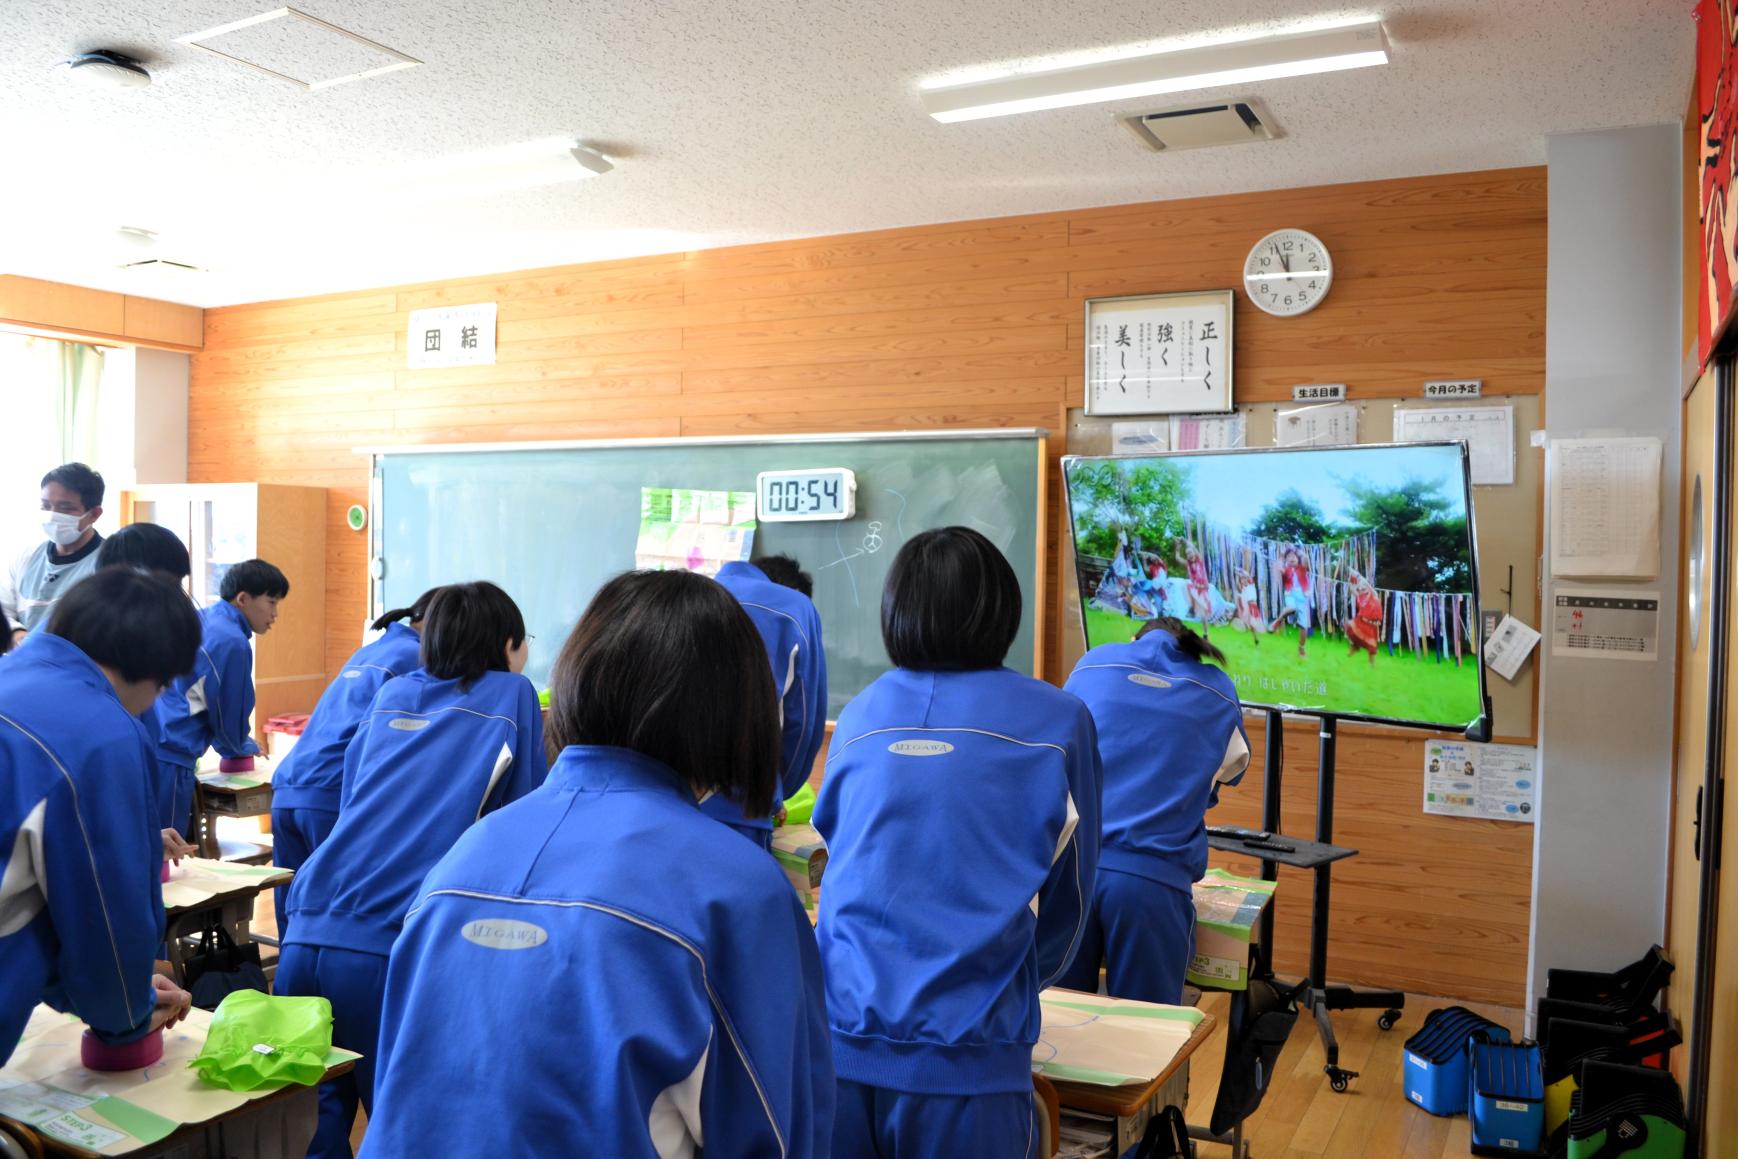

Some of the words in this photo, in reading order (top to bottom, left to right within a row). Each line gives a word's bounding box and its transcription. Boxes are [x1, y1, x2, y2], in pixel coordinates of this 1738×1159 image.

[1282, 241, 1294, 251] 12
[1260, 257, 1271, 266] 10
[1308, 253, 1316, 262] 2
[1261, 284, 1269, 294] 8
[1308, 280, 1316, 290] 4
[1271, 294, 1278, 303] 7
[1284, 296, 1292, 305] 6
[1299, 291, 1307, 301] 5
[424, 325, 478, 352] 団結
[1157, 322, 1174, 366] 強く
[1114, 324, 1131, 393] 美しく
[1199, 321, 1218, 390] 正しく
[1298, 387, 1340, 399] 生活目標
[1427, 384, 1478, 395] 今月の予定
[769, 480, 838, 513] 00:54
[471, 922, 538, 944] MIGAWA
